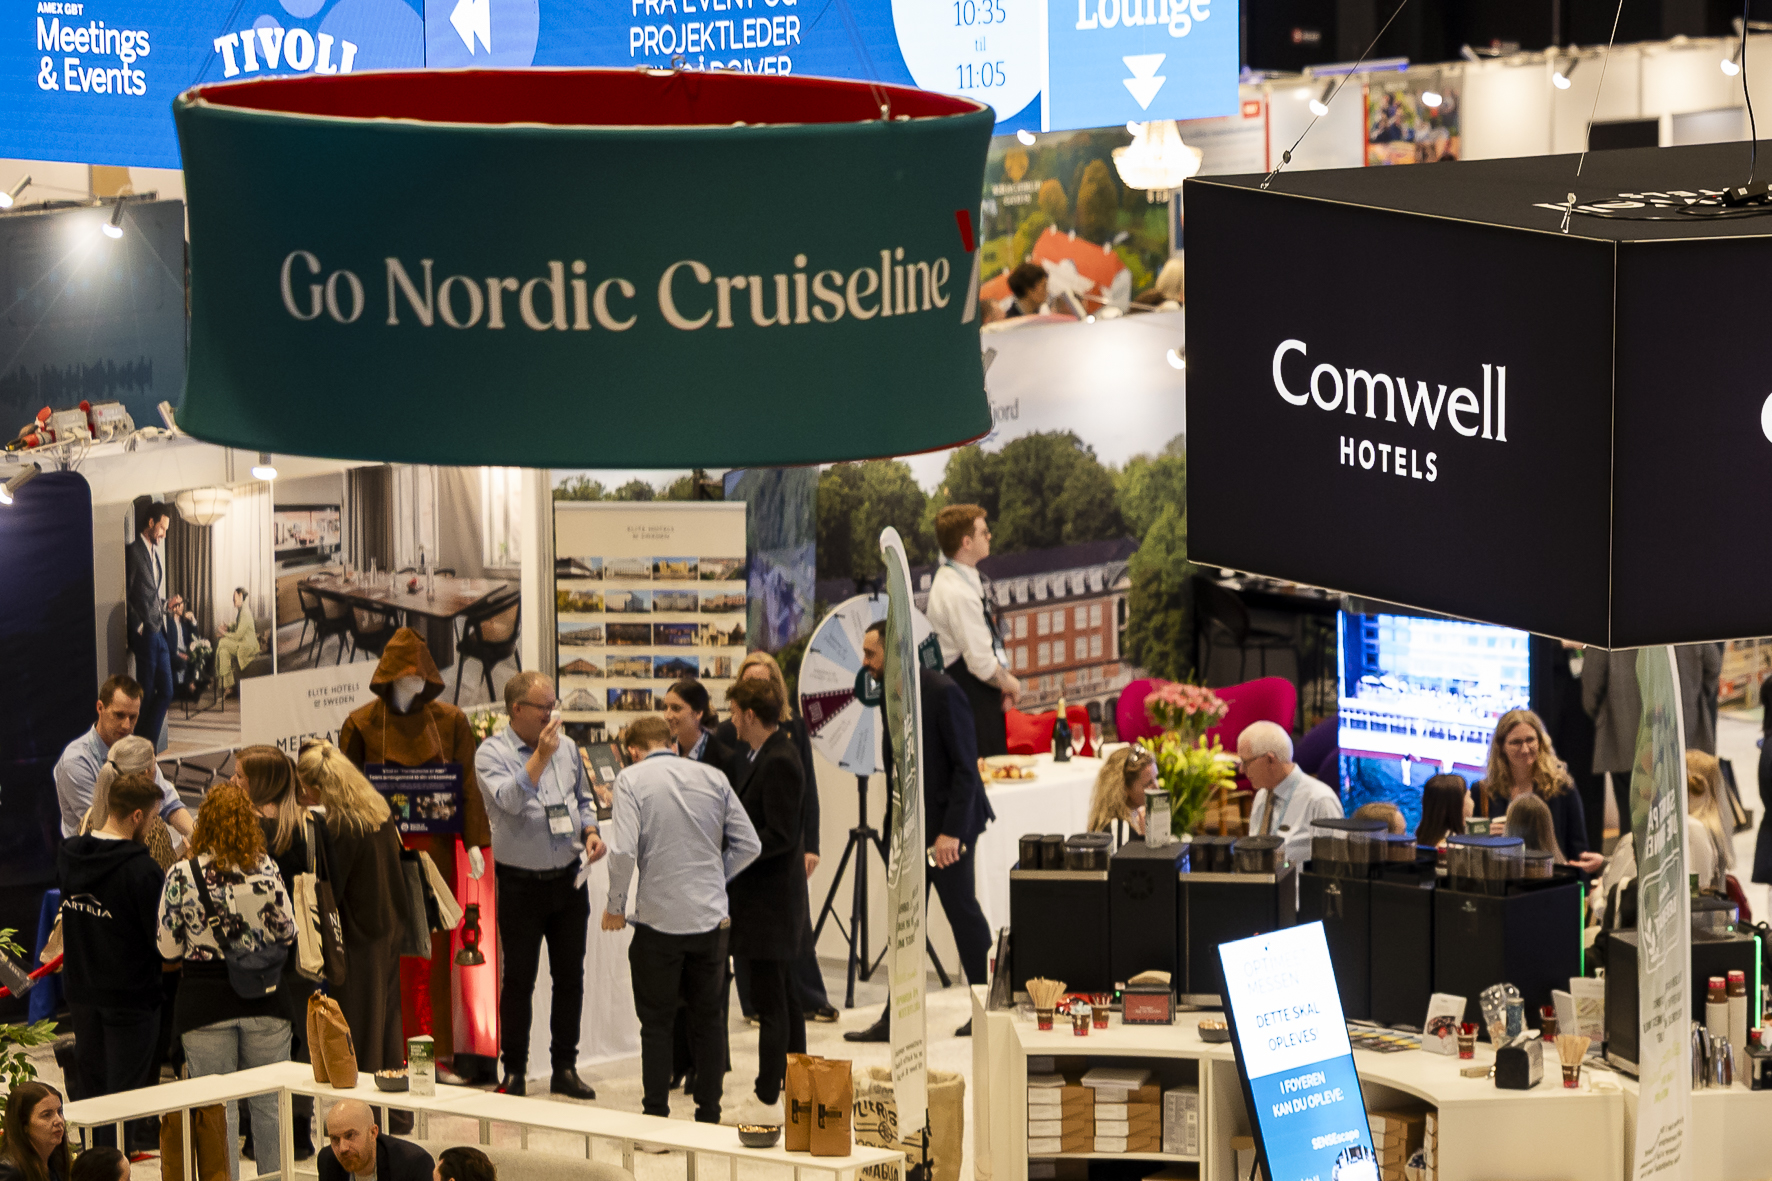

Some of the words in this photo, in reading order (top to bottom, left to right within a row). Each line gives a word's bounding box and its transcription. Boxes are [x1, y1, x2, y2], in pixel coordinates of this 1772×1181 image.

[37, 2, 64, 15] AMEX
[65, 3, 83, 16] GBT
[953, 0, 1006, 26] 10:35
[36, 16, 151, 63] Meetings
[629, 15, 800, 57] PROJEKTLEDER
[975, 37, 986, 51] til
[213, 27, 358, 79] TIVOLI
[37, 56, 59, 91] &
[64, 57, 147, 96] Events
[956, 61, 1006, 90] 11:05
[281, 250, 364, 323] Go
[384, 259, 638, 331] Nordic
[657, 246, 951, 331] Cruiseline
[1272, 339, 1507, 442] Comwell
[1340, 435, 1438, 482] HOTELS
[307, 684, 326, 698] ELITE
[328, 681, 360, 695] HOTELS
[323, 695, 355, 708] SWEDEN
[62, 899, 113, 919] ARTELIA
[1256, 1008, 1289, 1028] DETTE
[1292, 1003, 1321, 1022] SKAL
[1285, 1070, 1326, 1093] FOYEREN
[1272, 1101, 1293, 1118] KAN
[1293, 1095, 1308, 1115] DU
[1311, 1129, 1360, 1150] SENSEscape
